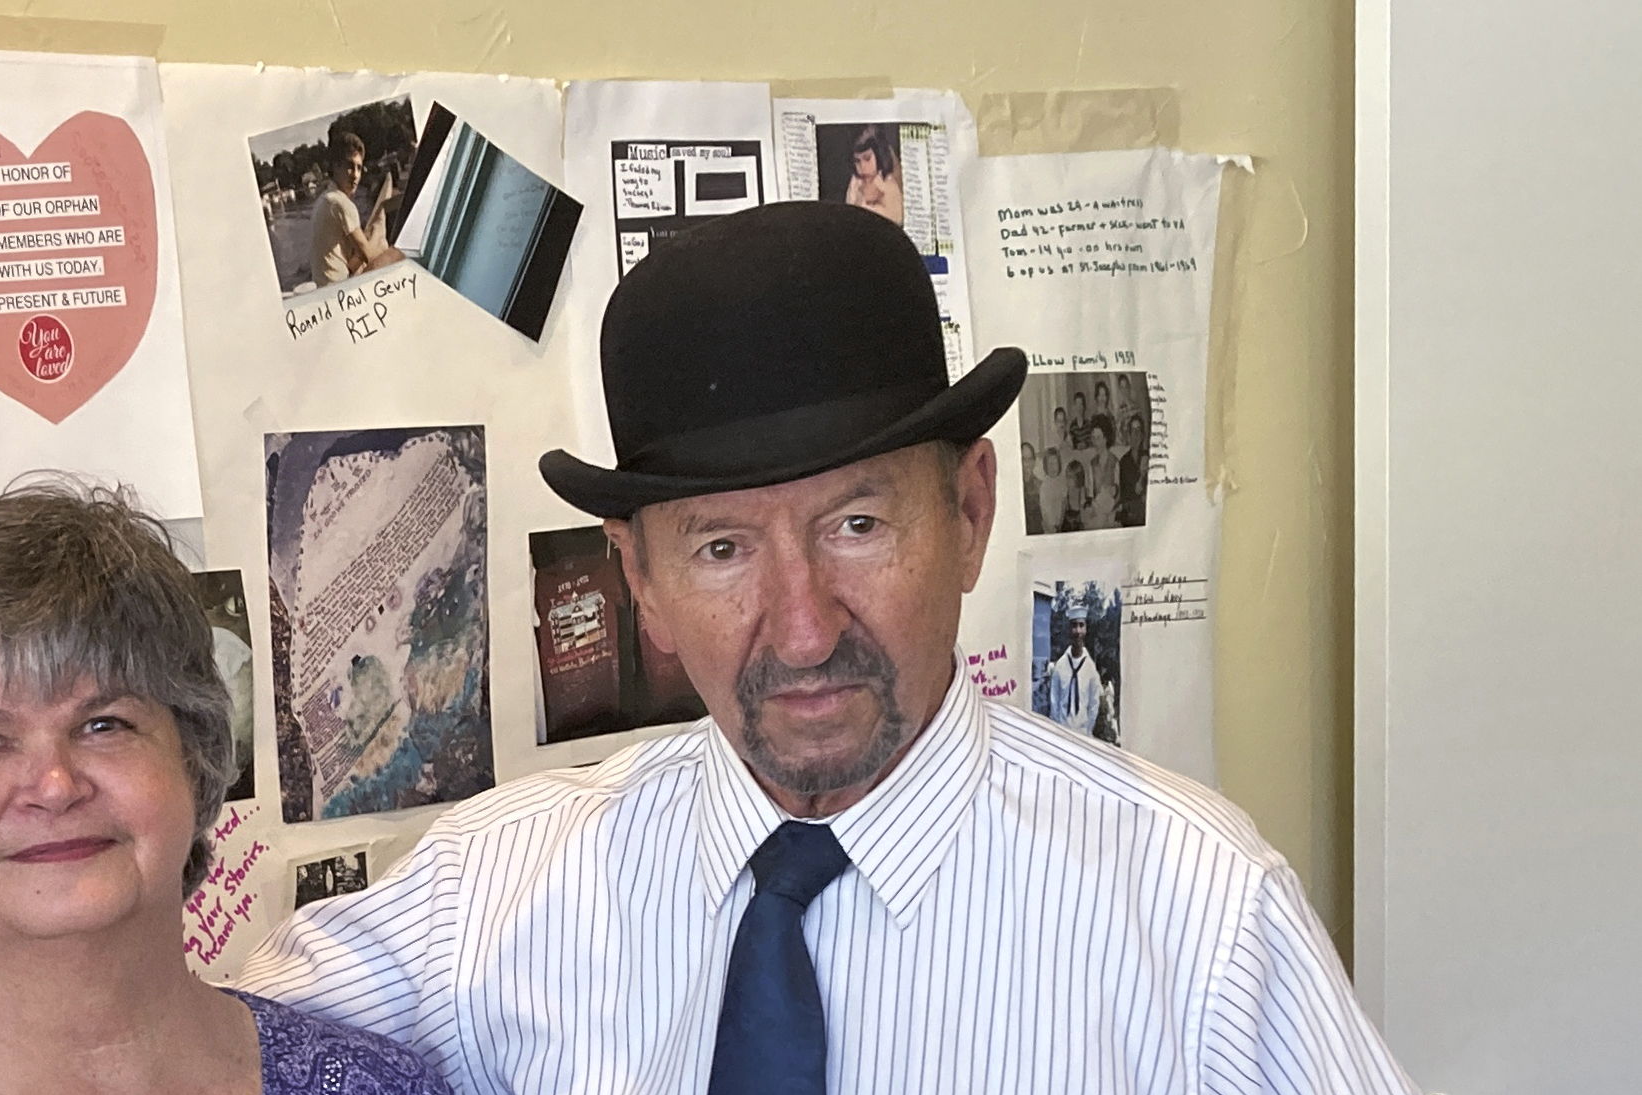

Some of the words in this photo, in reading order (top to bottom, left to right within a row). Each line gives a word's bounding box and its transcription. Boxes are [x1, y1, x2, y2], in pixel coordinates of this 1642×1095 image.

[628, 145, 666, 160] Music
[1, 167, 49, 181] HONOR
[53, 165, 70, 179] OF
[13, 202, 41, 216] OUR
[45, 198, 98, 214] ORPHAN
[998, 208, 1033, 222] Mom
[1038, 204, 1063, 216] was
[65, 231, 95, 244] WHO
[98, 229, 123, 243] ARE
[1001, 225, 1027, 240] Dad
[1002, 247, 1027, 257] Tom
[35, 261, 54, 276] US
[62, 294, 71, 306] &
[73, 289, 121, 305] FUTURE
[346, 302, 387, 344] RIP
[19, 320, 60, 357] You
[45, 343, 66, 361] are
[36, 353, 71, 377] loved
